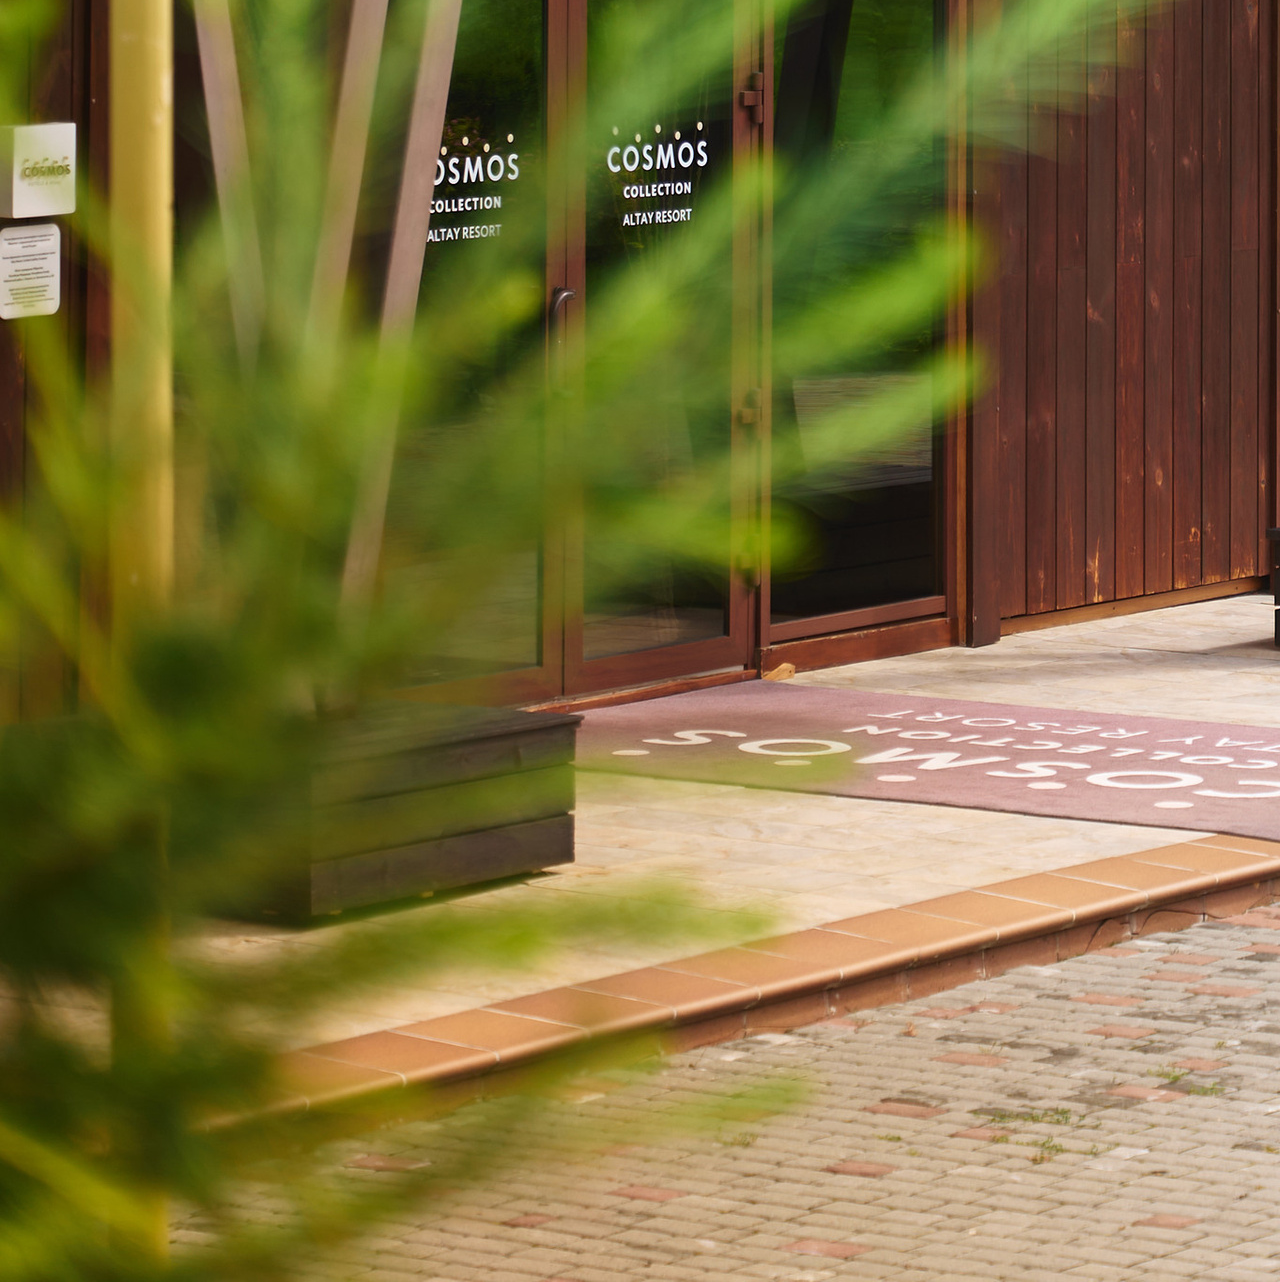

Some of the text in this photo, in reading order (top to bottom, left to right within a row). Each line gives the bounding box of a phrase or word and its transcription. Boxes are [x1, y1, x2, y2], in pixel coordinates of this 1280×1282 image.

[606, 139, 709, 173] COSMOS
[623, 181, 692, 200] COLLECTION
[429, 196, 502, 215] COLLECTION
[621, 208, 693, 227] ALTAY RESORT
[426, 223, 502, 243] ALTAY RESORT
[866, 710, 1151, 740] RESORT
[841, 725, 1279, 770] COLLECTION
